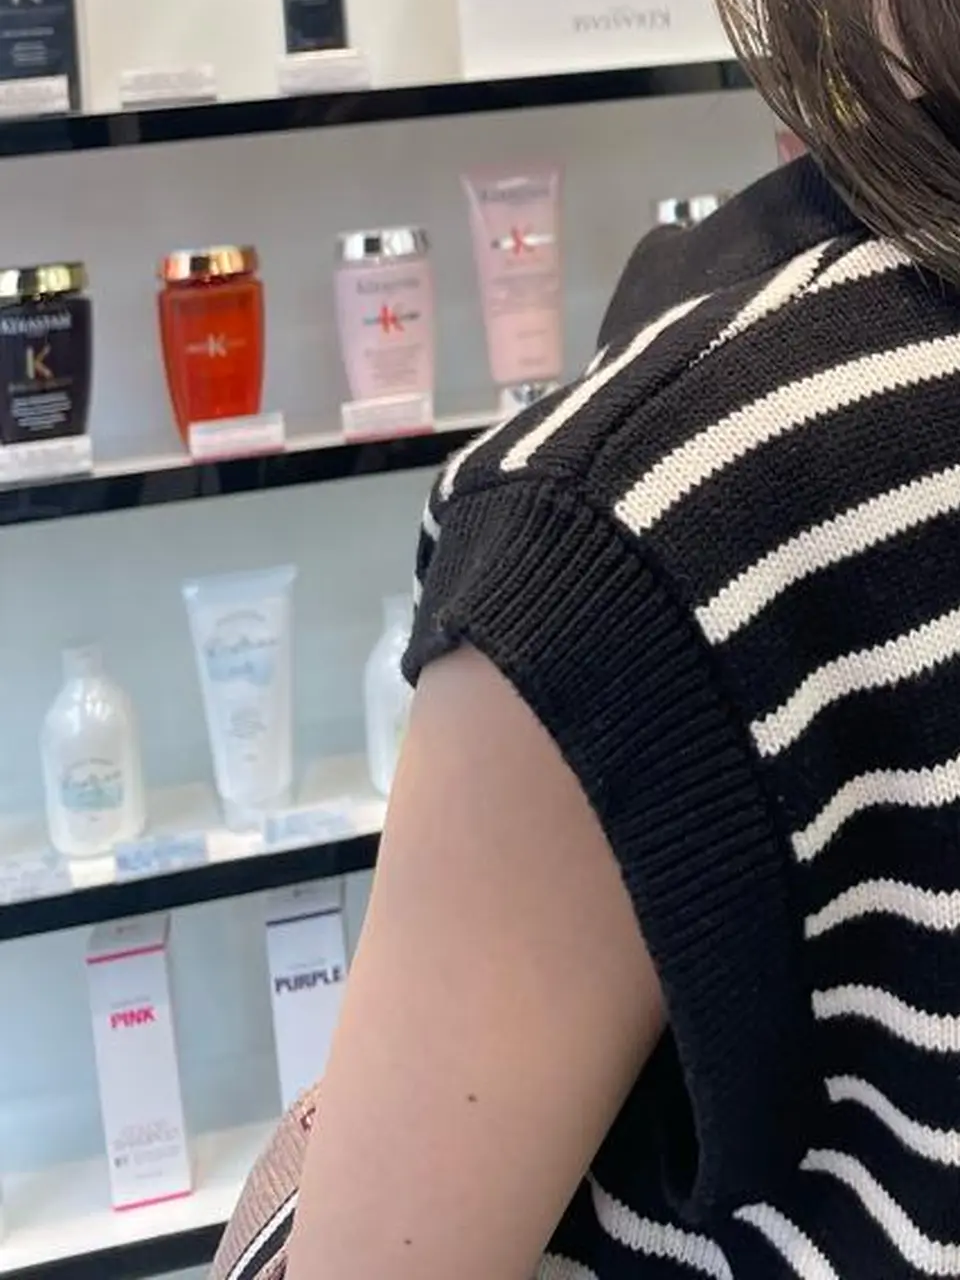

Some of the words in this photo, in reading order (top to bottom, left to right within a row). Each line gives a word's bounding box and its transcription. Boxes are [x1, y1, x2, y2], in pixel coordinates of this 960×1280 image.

[207, 332, 228, 358] K
[26, 344, 54, 381] K
[275, 966, 342, 996] PURPLE
[110, 1006, 156, 1029] PINK
